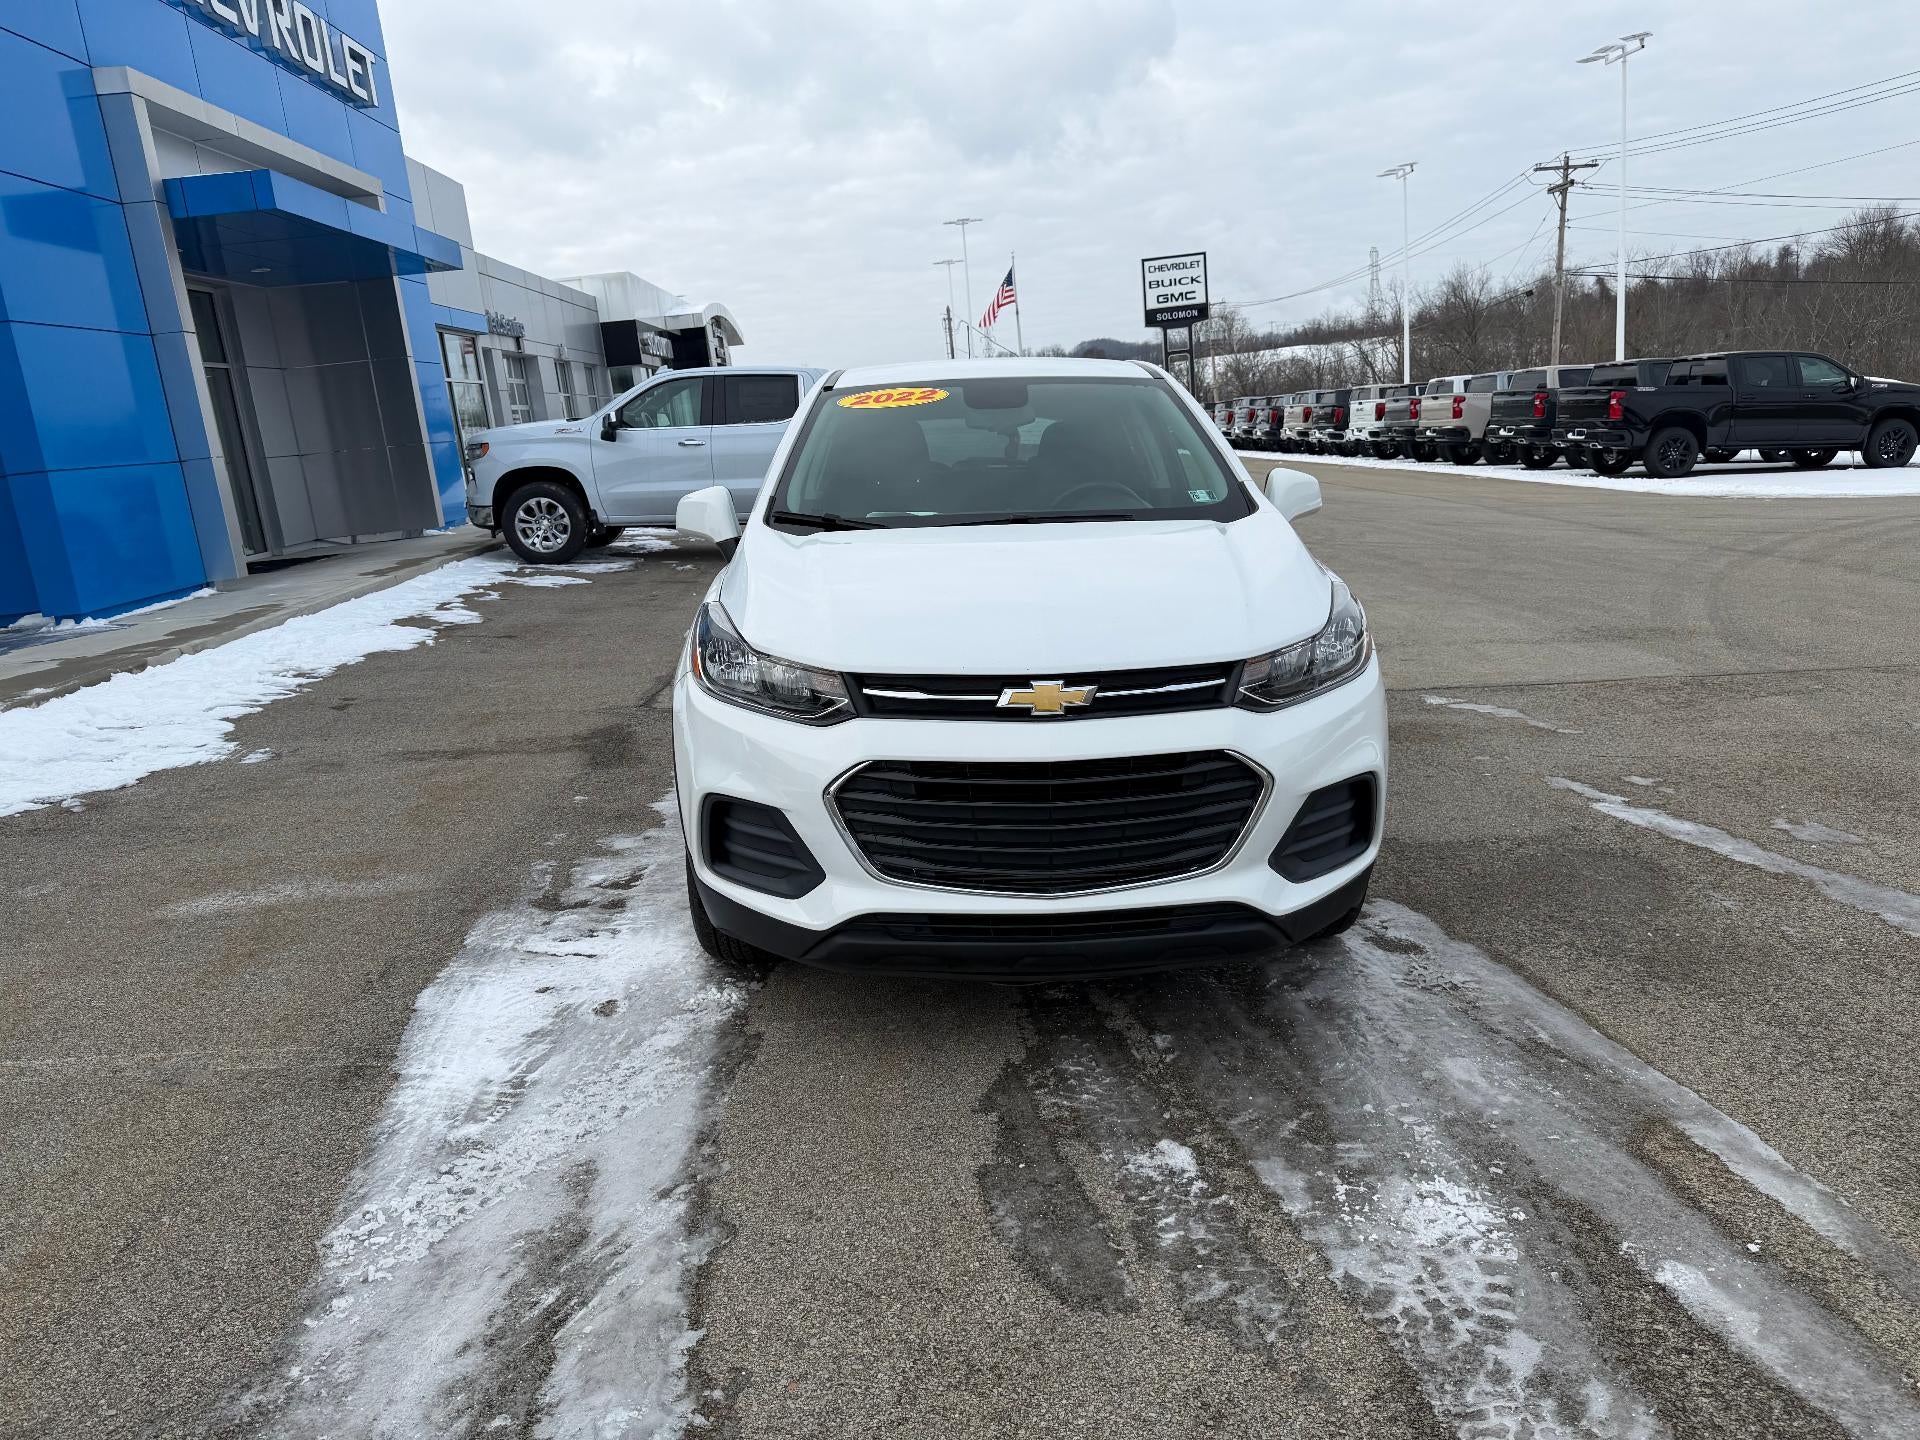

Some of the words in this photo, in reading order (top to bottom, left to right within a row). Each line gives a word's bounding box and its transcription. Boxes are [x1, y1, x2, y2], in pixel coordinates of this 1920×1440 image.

[1148, 260, 1200, 273] CHEVROLET
[1148, 275, 1202, 289] BUICK
[1156, 290, 1197, 304] GMC
[1156, 309, 1198, 321] SOLOMON
[849, 389, 939, 406] 2022
